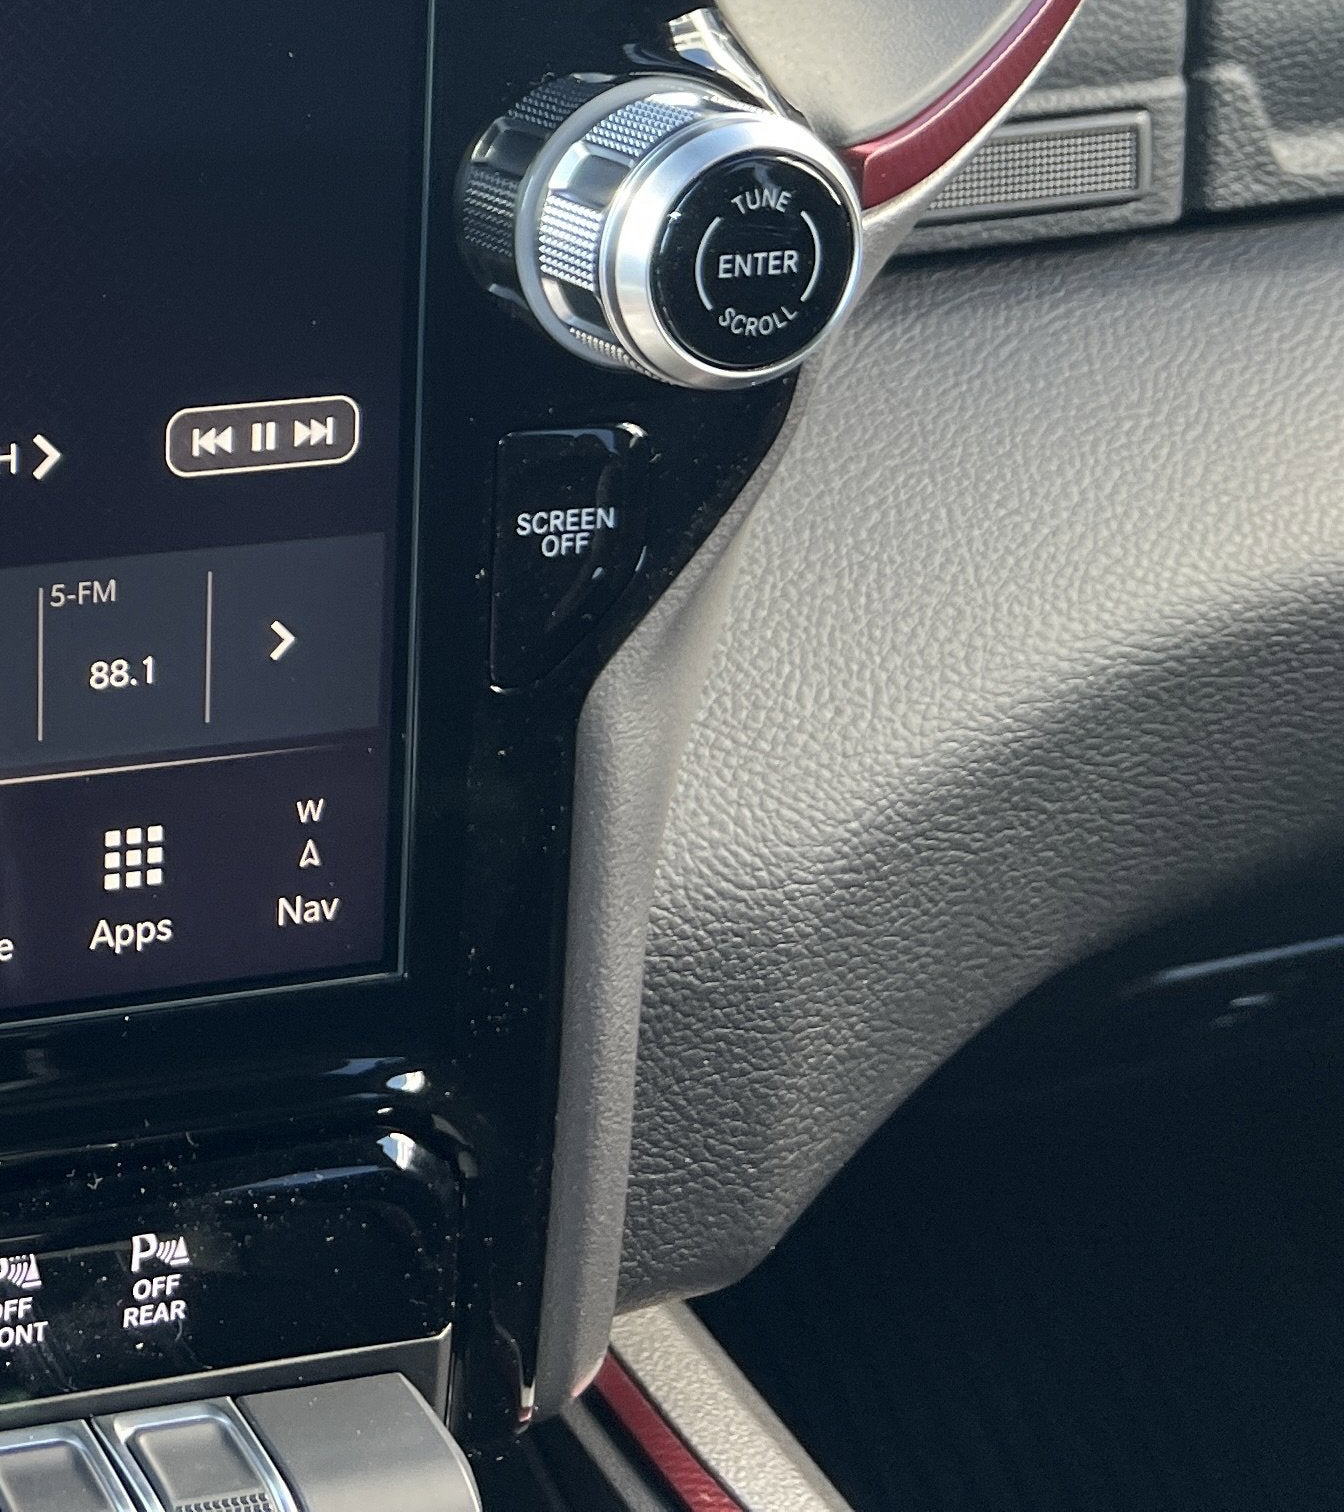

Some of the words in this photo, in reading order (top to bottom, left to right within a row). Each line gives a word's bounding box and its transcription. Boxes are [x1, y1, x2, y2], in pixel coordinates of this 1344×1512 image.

[730, 187, 793, 216] TUNE
[717, 250, 799, 280] ENTER
[718, 303, 799, 337] SCROLL
[515, 506, 616, 537] SCREEN
[540, 532, 591, 558] OFF
[49, 579, 117, 608] 5-FM
[88, 655, 157, 690] 88.1
[296, 798, 325, 824] W
[277, 896, 340, 927] Nav
[89, 916, 174, 954] Apps
[131, 1273, 181, 1300] OFF
[122, 1299, 187, 1329] REAR
